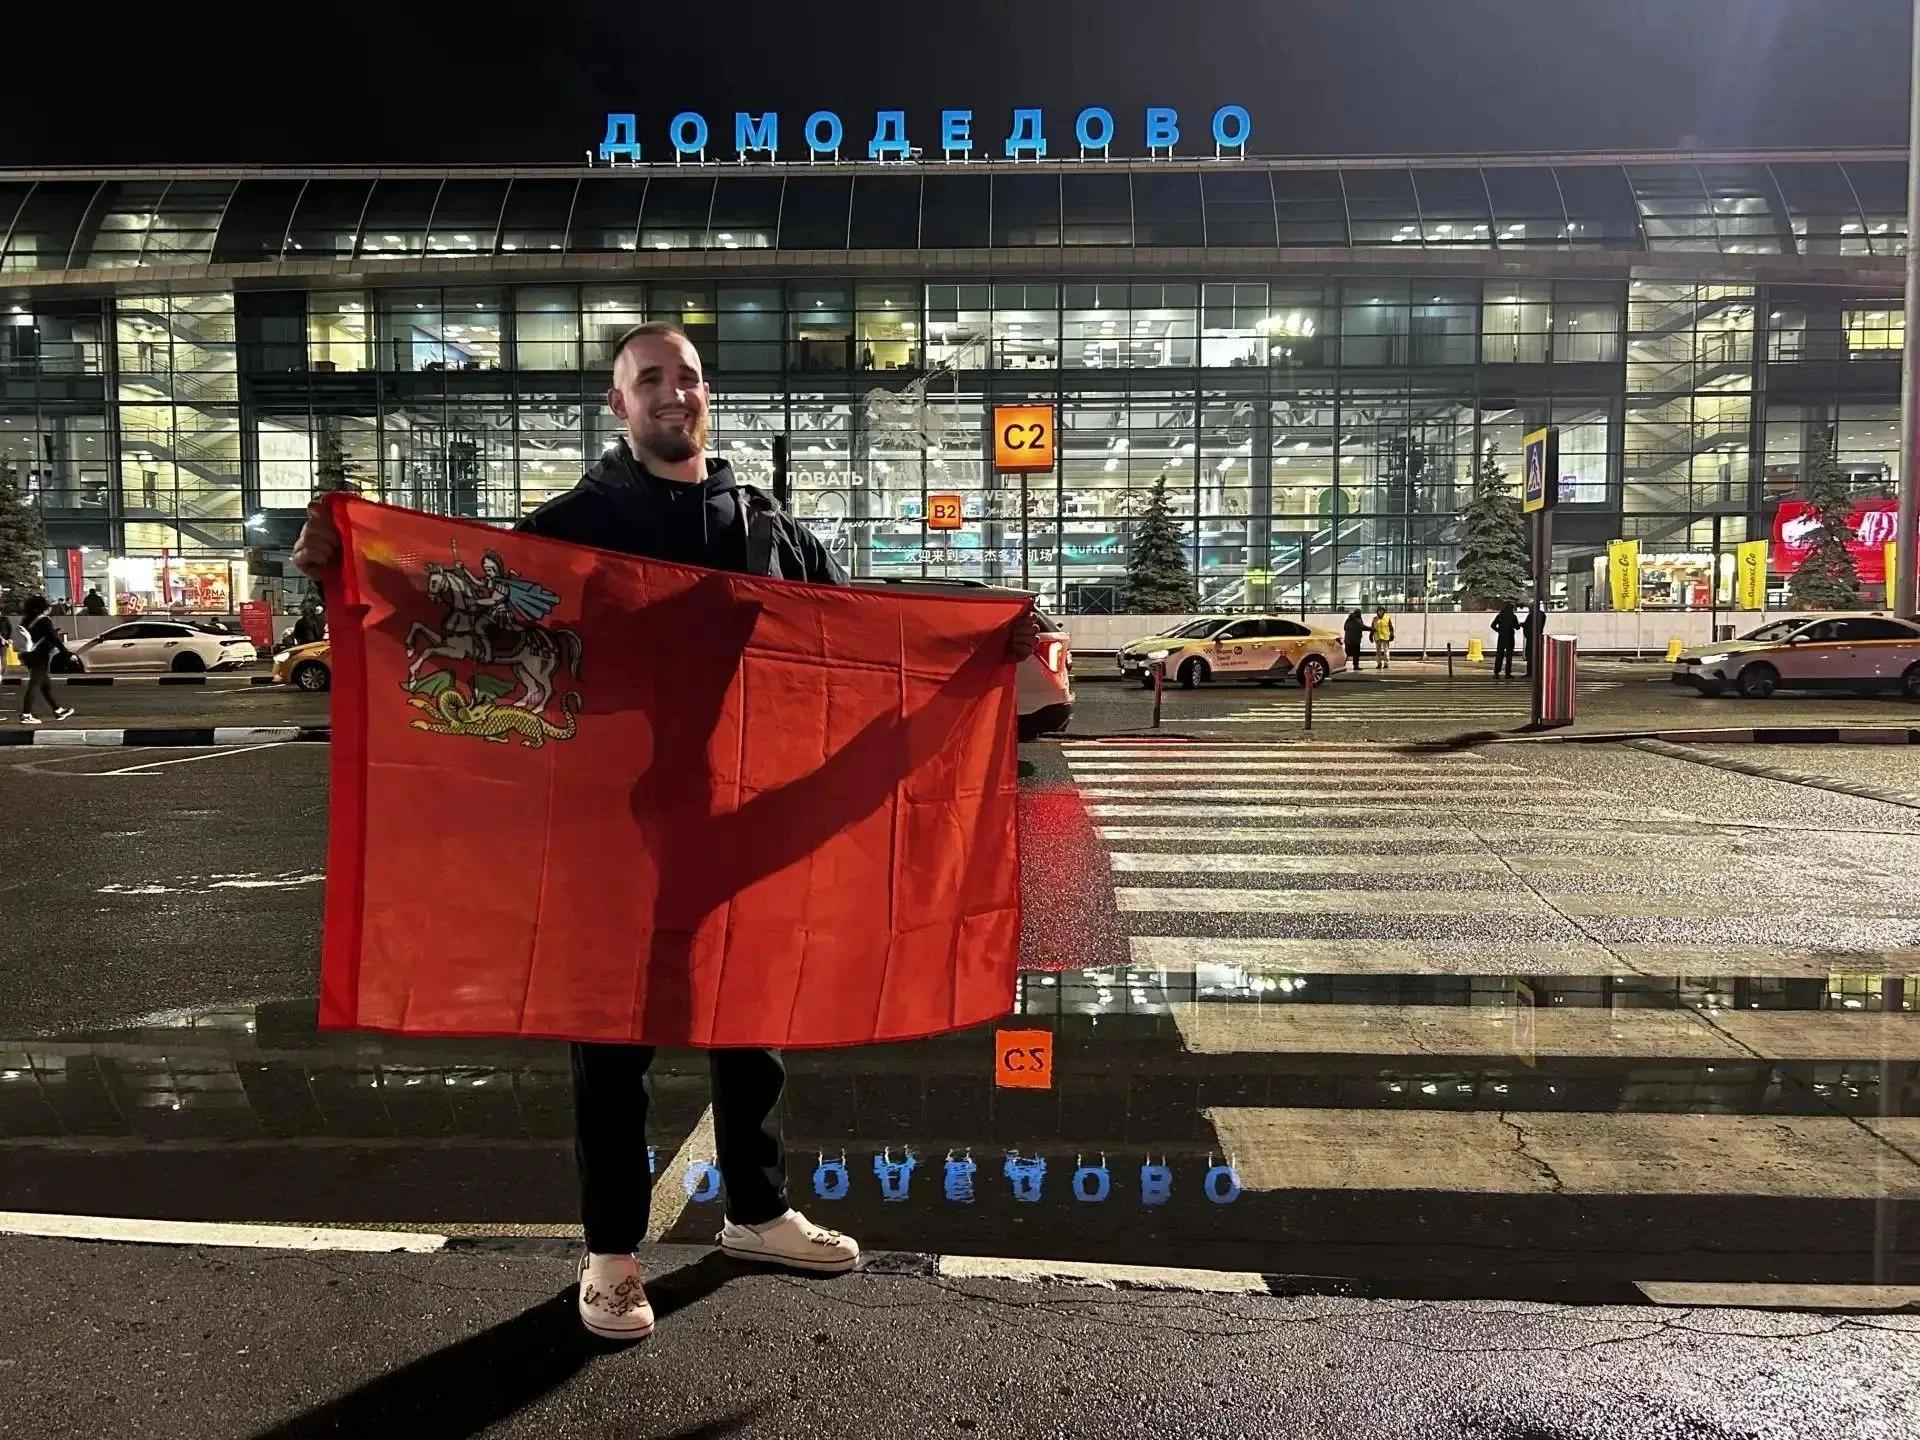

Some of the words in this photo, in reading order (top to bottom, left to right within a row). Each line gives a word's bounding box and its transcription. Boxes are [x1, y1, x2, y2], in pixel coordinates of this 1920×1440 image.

[599, 104, 1252, 161] ДОМОДЕДОВО
[1004, 423, 1045, 451] C2
[735, 472, 864, 486] ОЖЛОВАТЬ
[934, 504, 956, 519] B2
[1619, 554, 1629, 568] Go
[1746, 553, 1756, 566] Go
[1622, 568, 1630, 598] Яндекс
